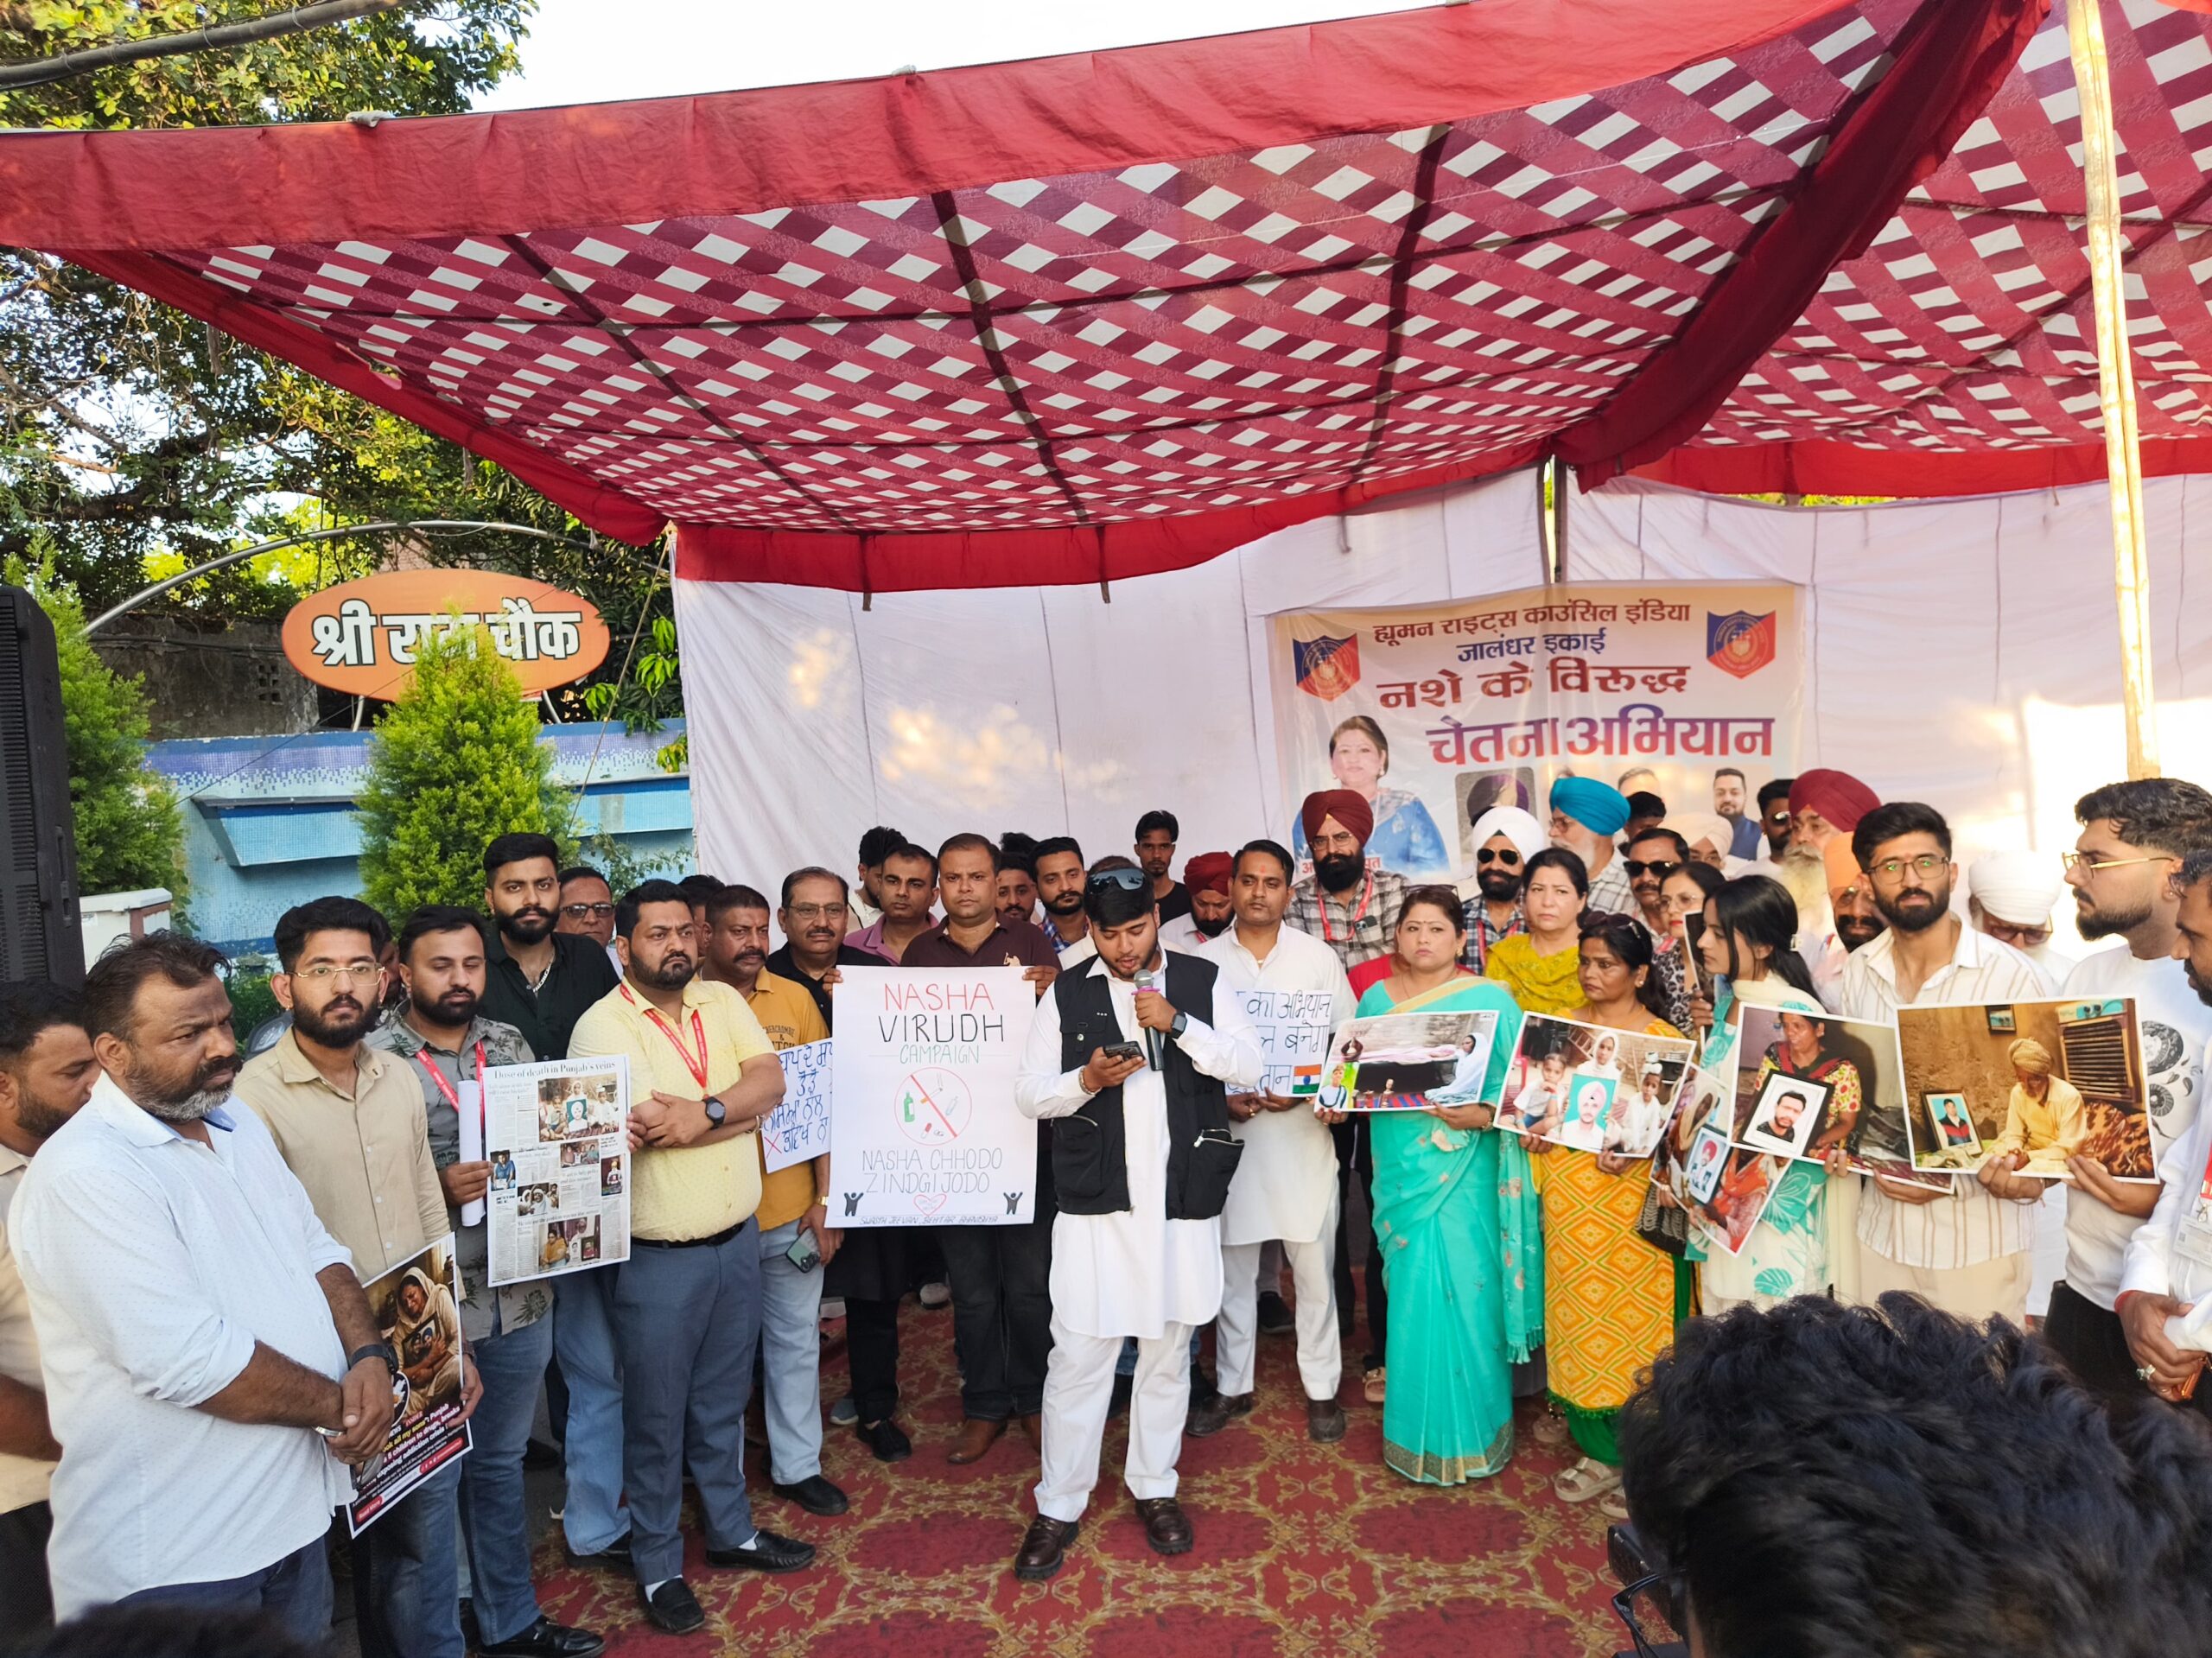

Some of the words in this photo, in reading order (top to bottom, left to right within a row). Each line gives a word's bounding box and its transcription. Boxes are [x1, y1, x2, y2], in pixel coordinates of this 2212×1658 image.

[312, 598, 378, 666] श्री
[484, 596, 583, 661] चौक
[1372, 621, 1434, 647] ह्यूमन
[1440, 610, 1517, 634] राइट्स
[1522, 599, 1618, 624] काउंसिल
[1624, 598, 1691, 624] इंडिया
[1456, 633, 1536, 663] जालंधर
[1542, 626, 1607, 654] इकाई
[1376, 668, 1463, 708] नशे
[1477, 660, 1535, 698] के
[1426, 715, 1559, 765] चेतना
[1565, 703, 1776, 757] अभियान
[884, 982, 995, 1011] NASHA
[1277, 989, 1332, 1019] अभियान
[878, 1013, 1004, 1042] VIRUDH
[899, 1044, 980, 1064] CAMPAIGN
[494, 1068, 517, 1079] Dose
[517, 1069, 526, 1077] of
[526, 1064, 550, 1077] death
[550, 1064, 559, 1073] in
[560, 1062, 594, 1075] Punjab's
[594, 1062, 615, 1070] veins
[862, 1148, 923, 1172] NASHA
[930, 1147, 1002, 1170] CHHODO
[864, 1172, 937, 1194] ZINDGI
[941, 1172, 990, 1194] JODO
[392, 1436, 416, 1457] children
